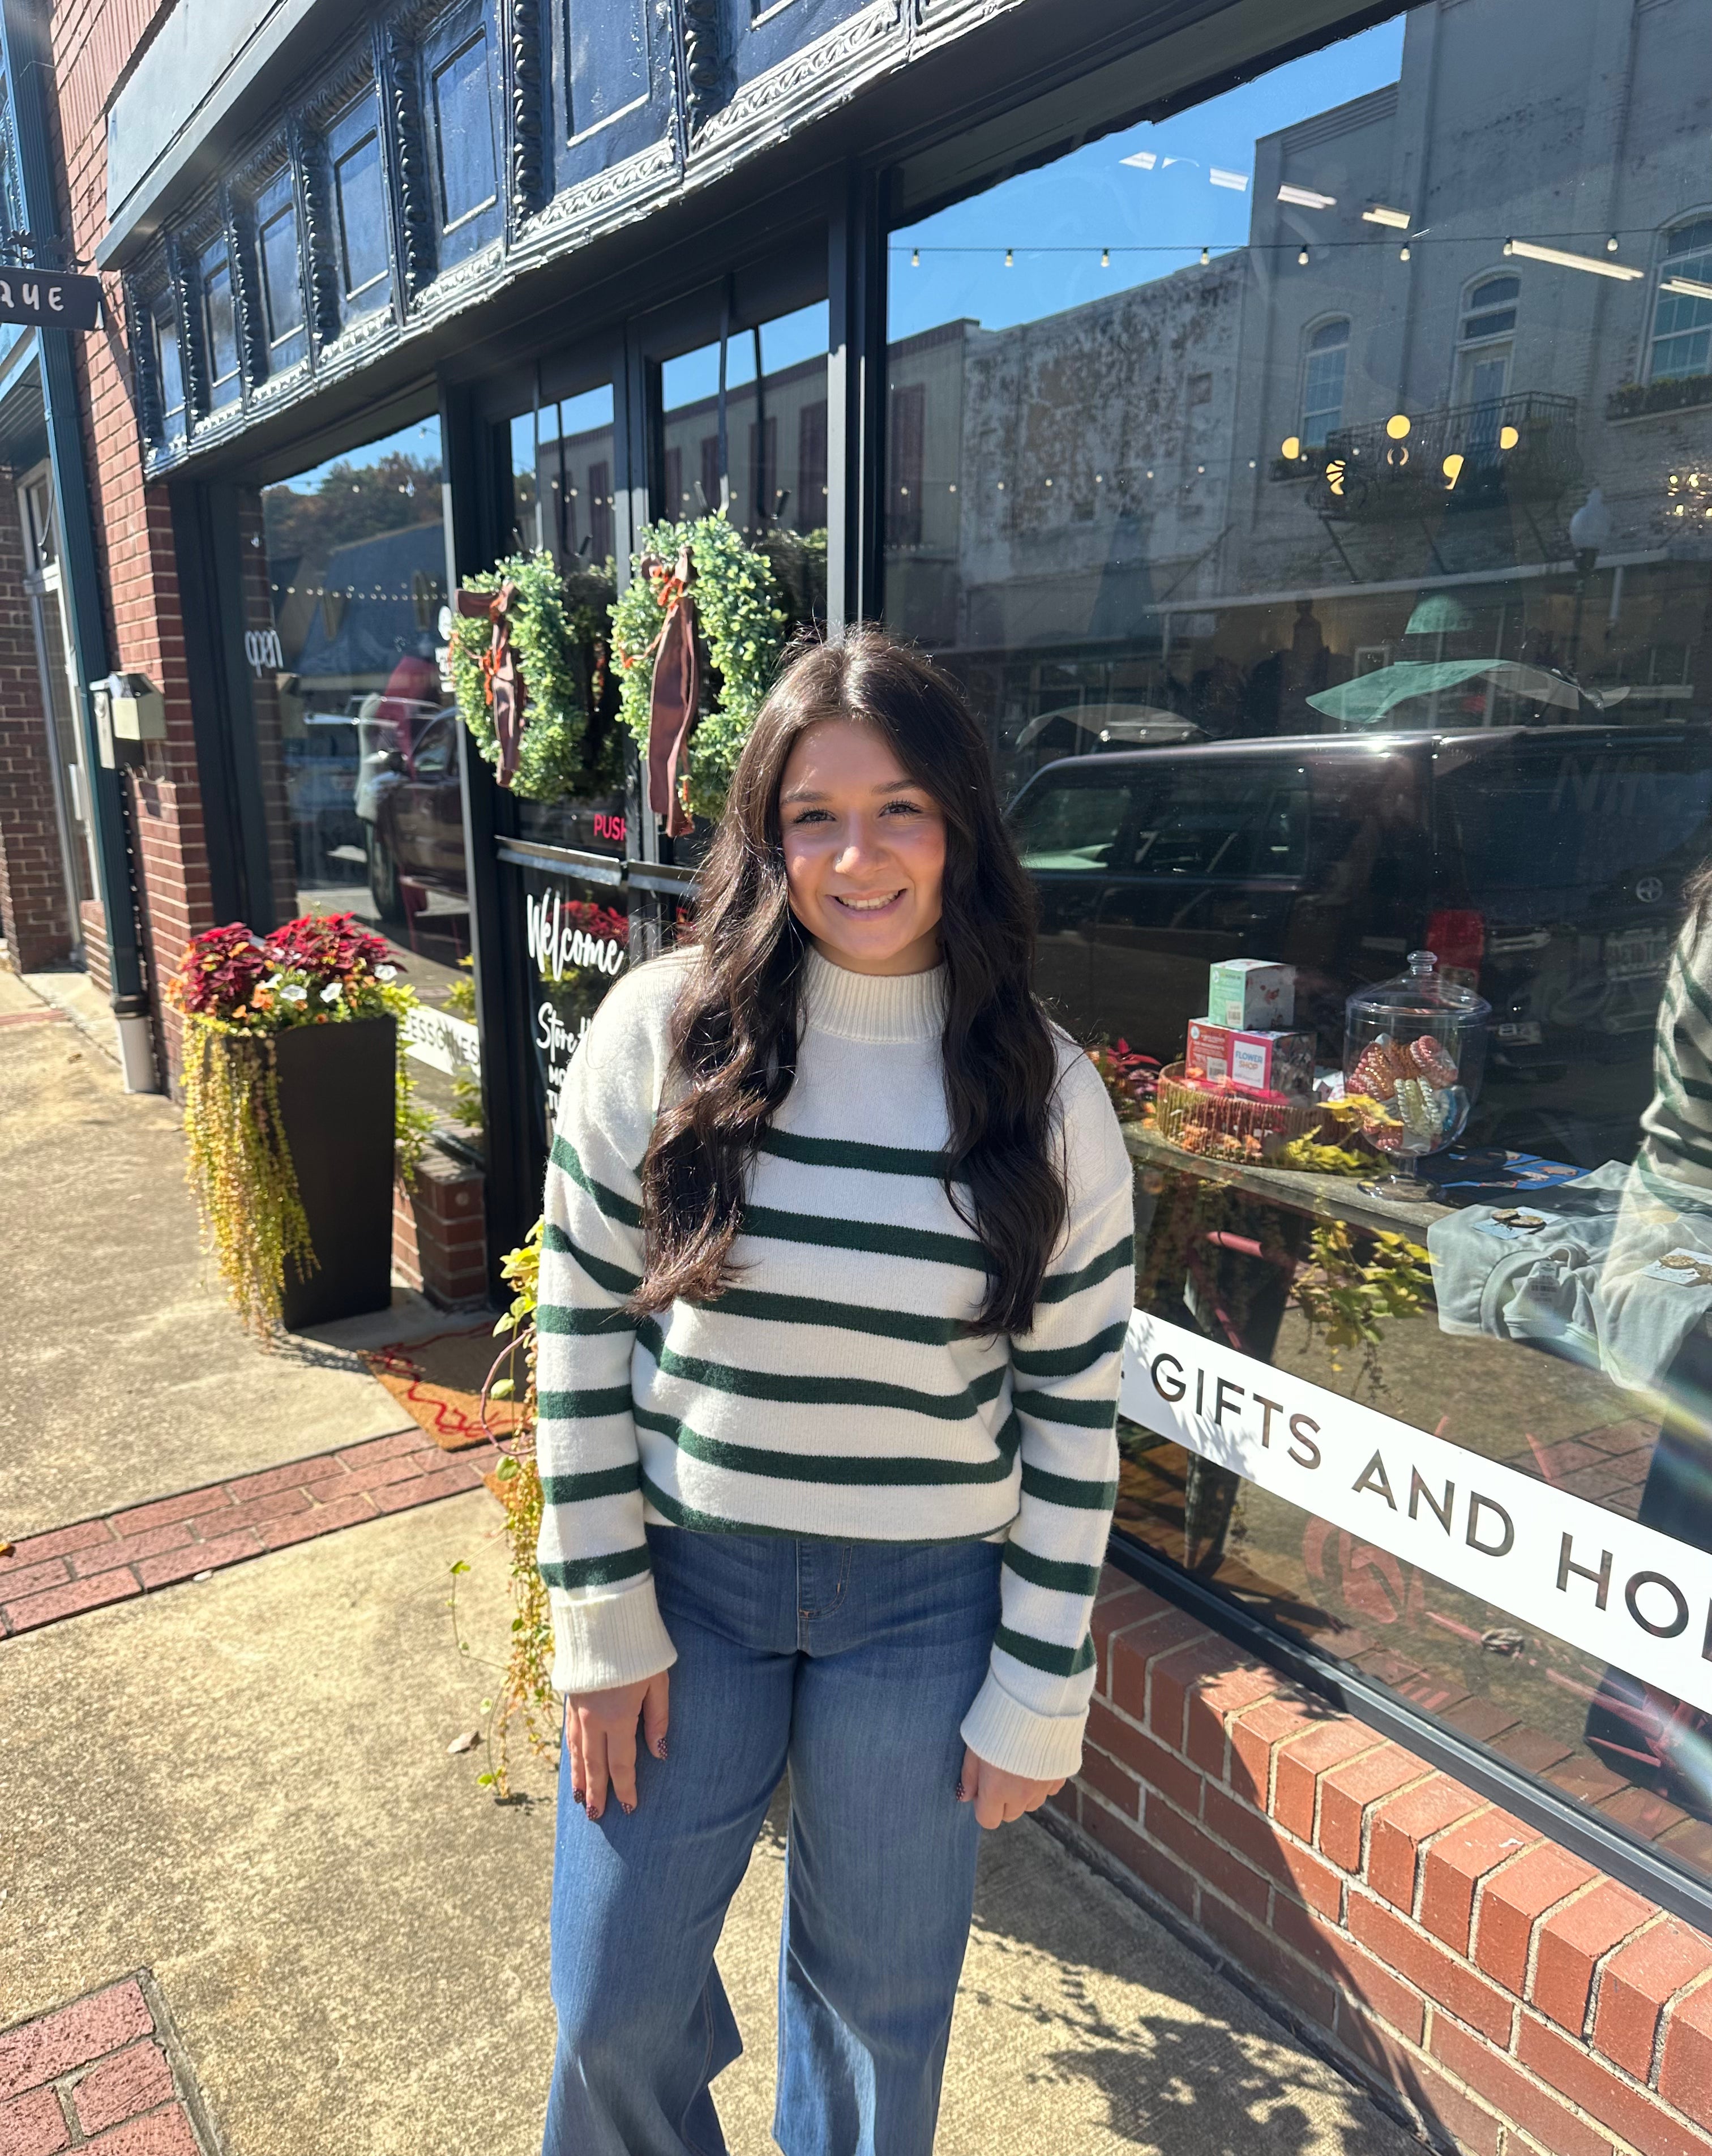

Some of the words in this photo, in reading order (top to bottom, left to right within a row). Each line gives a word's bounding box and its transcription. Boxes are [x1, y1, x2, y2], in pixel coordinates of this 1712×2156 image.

[245, 630, 283, 679] open
[594, 814, 627, 841] PUSH
[527, 887, 624, 982] Welcome
[536, 1002, 578, 1062] Store
[1235, 1050, 1263, 1064] FLOWER
[1238, 1060, 1259, 1070] SHOP
[1150, 1353, 1322, 1470] GIFTS
[1351, 1448, 1514, 1558] AND
[1556, 1532, 1712, 1663] HO
